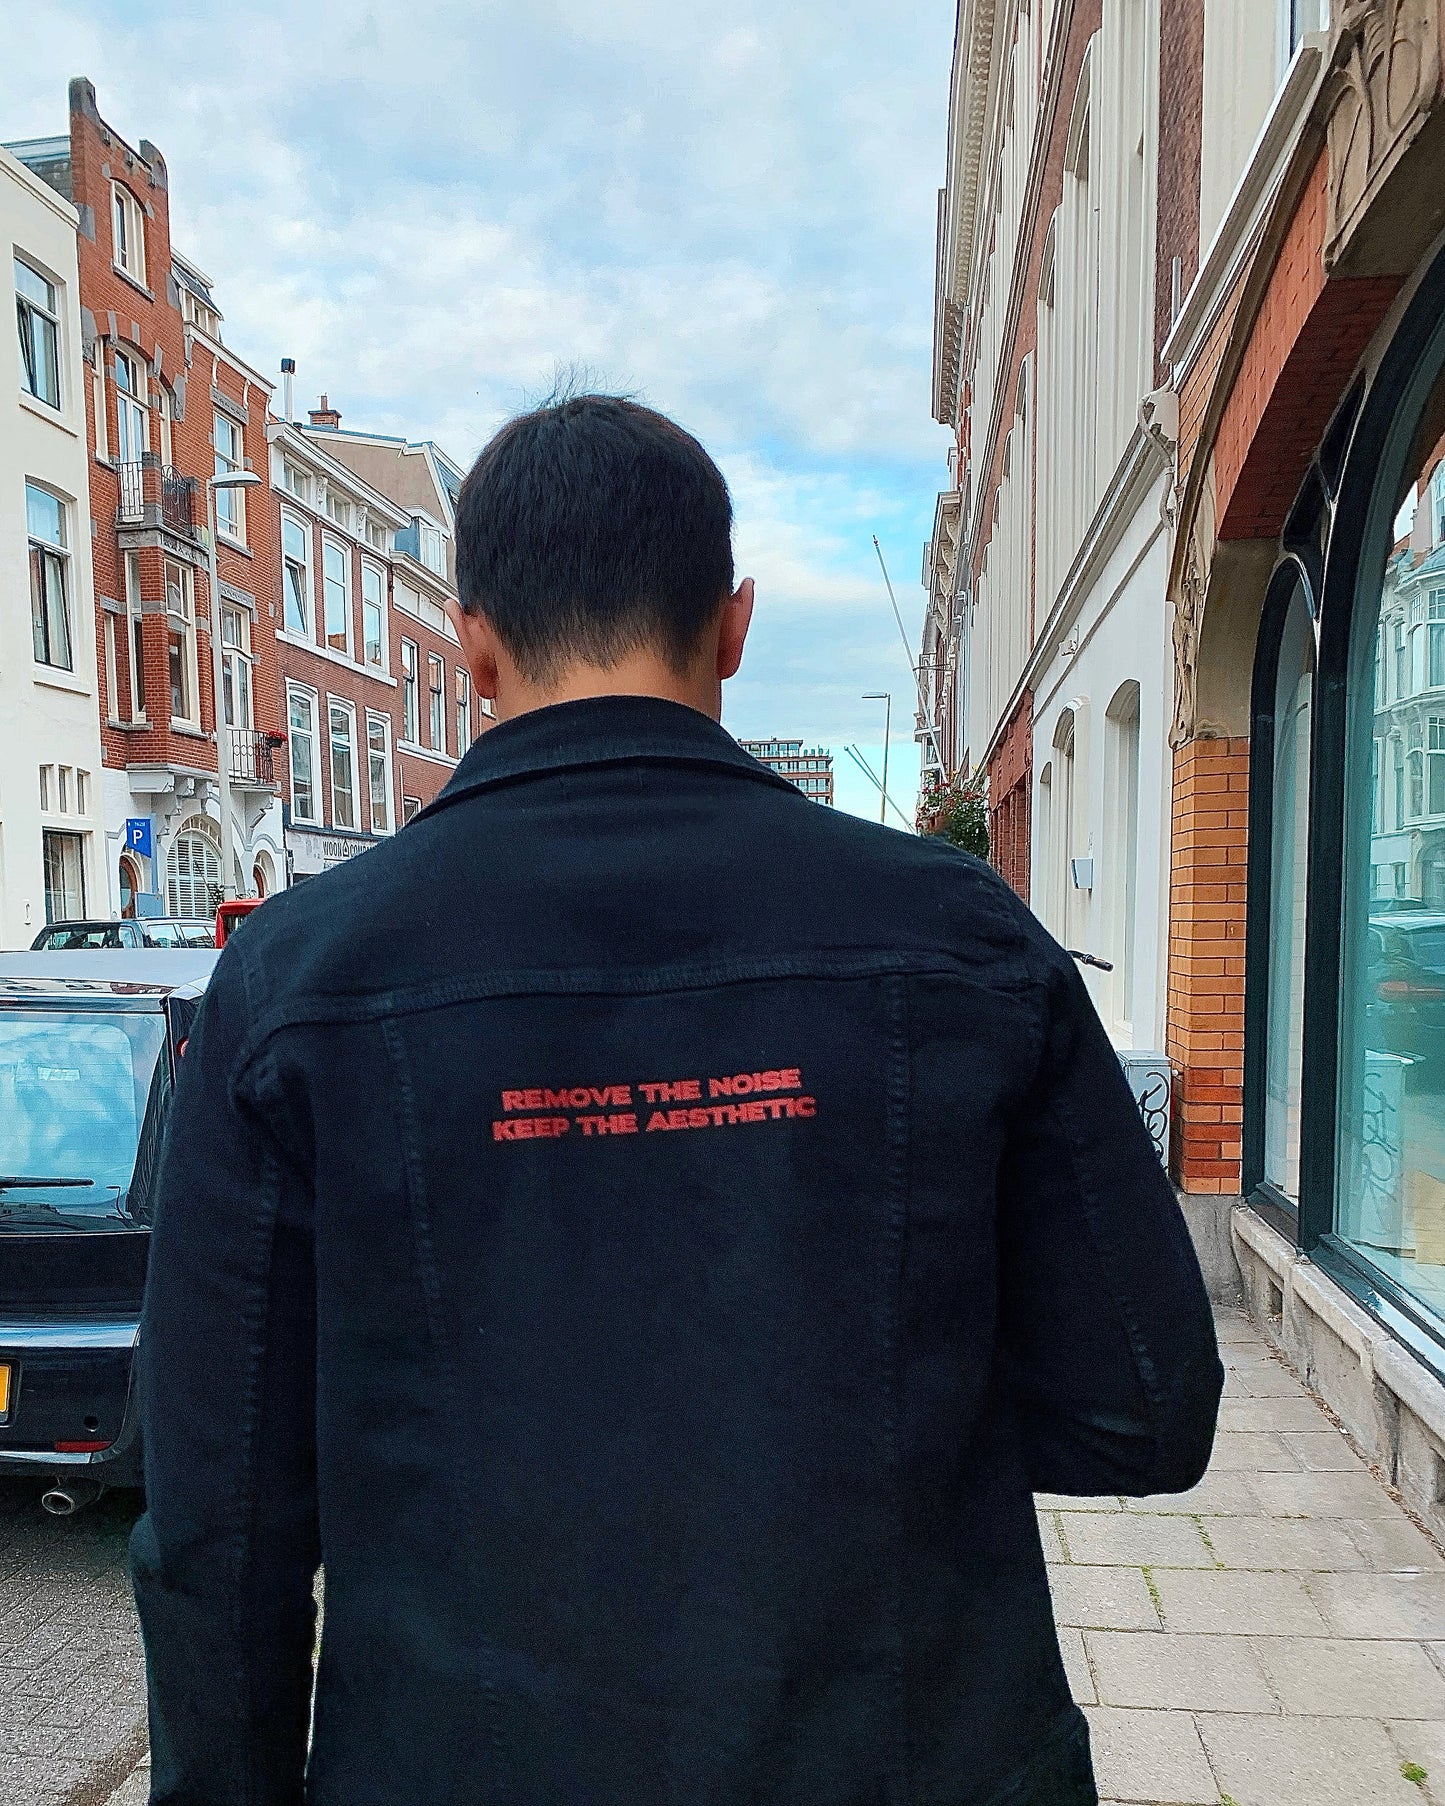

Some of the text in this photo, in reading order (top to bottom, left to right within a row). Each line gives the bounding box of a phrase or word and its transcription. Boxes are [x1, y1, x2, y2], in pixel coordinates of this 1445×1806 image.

[133, 829, 143, 845] P
[323, 841, 342, 857] WOON
[502, 1068, 801, 1111] REMOVE THE NOISE
[493, 1097, 816, 1141] KEEP THE AESTHETIC
